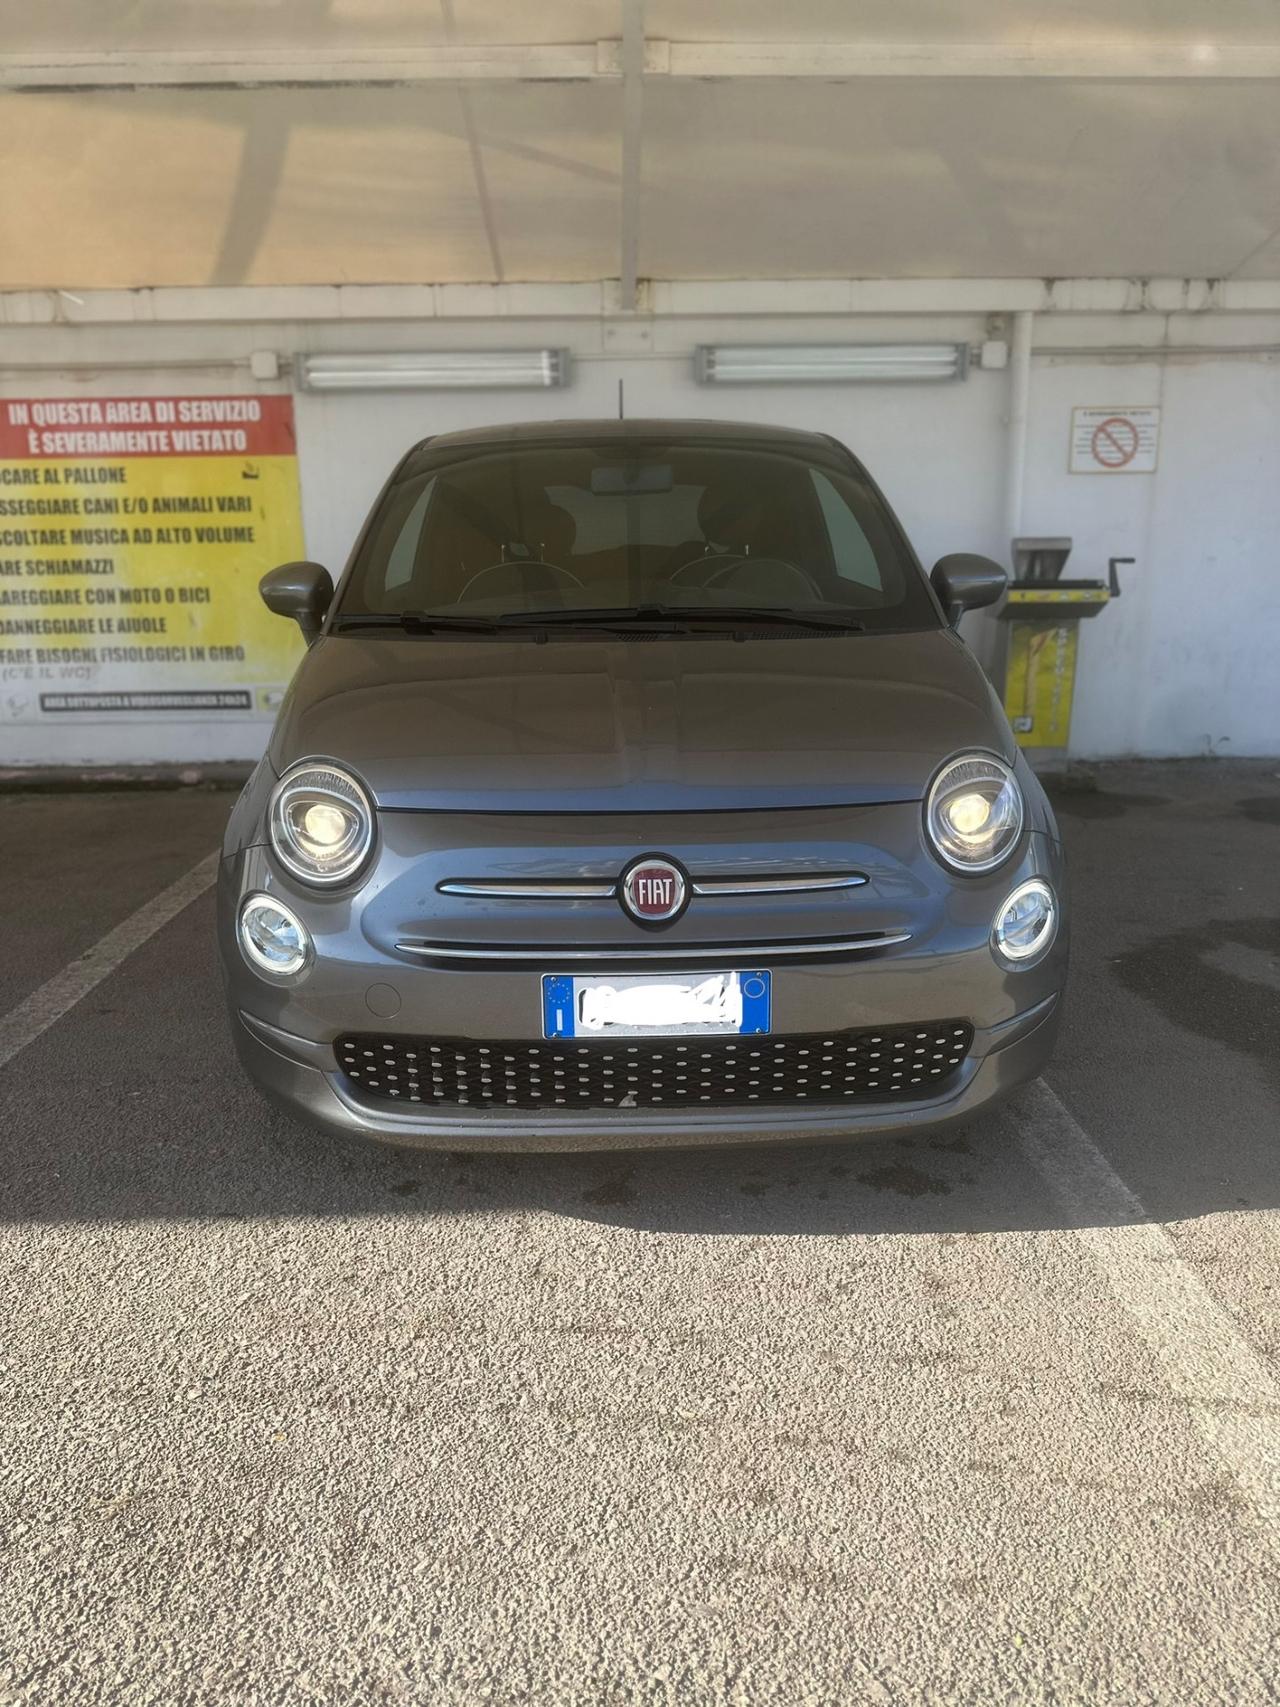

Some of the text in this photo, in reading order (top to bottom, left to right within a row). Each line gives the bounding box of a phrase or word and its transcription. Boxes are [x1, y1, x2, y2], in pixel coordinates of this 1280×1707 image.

[8, 400, 261, 427] IN QUESTA AREA DI SERVIZIO
[28, 428, 247, 454] È SEVERAMENTE VIETATO
[0, 467, 127, 485] CARE AL PALLONE
[83, 498, 119, 515] CANI
[123, 497, 148, 514] E/O
[152, 496, 213, 514] ANIMALI
[216, 496, 252, 513] VARI
[70, 529, 129, 545] MUSICA
[133, 528, 153, 544] AD
[157, 528, 192, 544] ALTO
[195, 527, 255, 544] VOLUME
[25, 559, 115, 575] SCHIAMAZZI
[85, 588, 116, 605] CON
[119, 587, 162, 604] MOTO
[165, 587, 175, 604] O
[178, 587, 210, 603] BICI
[99, 618, 115, 635] LE
[117, 617, 167, 634] AIUOLE
[36, 648, 98, 664] BISOGNI
[190, 646, 206, 662] IN
[209, 645, 246, 662] GIRO
[638, 879, 673, 905] FIAT
